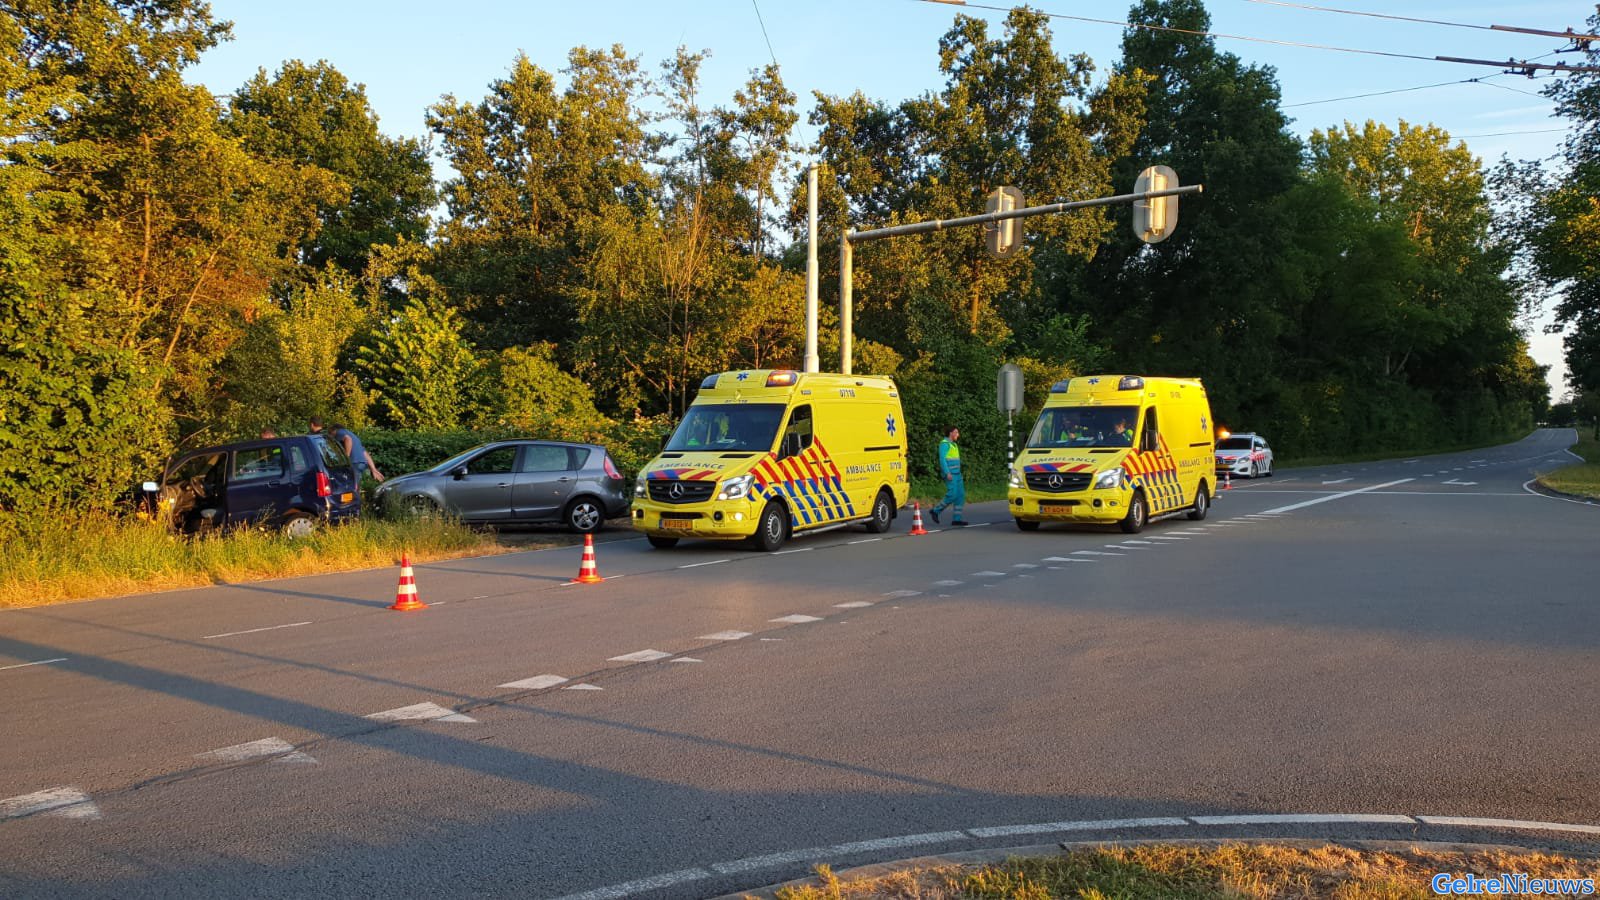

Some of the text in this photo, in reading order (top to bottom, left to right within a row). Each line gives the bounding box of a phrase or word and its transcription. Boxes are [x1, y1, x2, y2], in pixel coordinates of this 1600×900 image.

[1031, 456, 1097, 464] AMBULANCE
[657, 462, 725, 470] AMBULANCE
[846, 463, 881, 475] AMBULANCE
